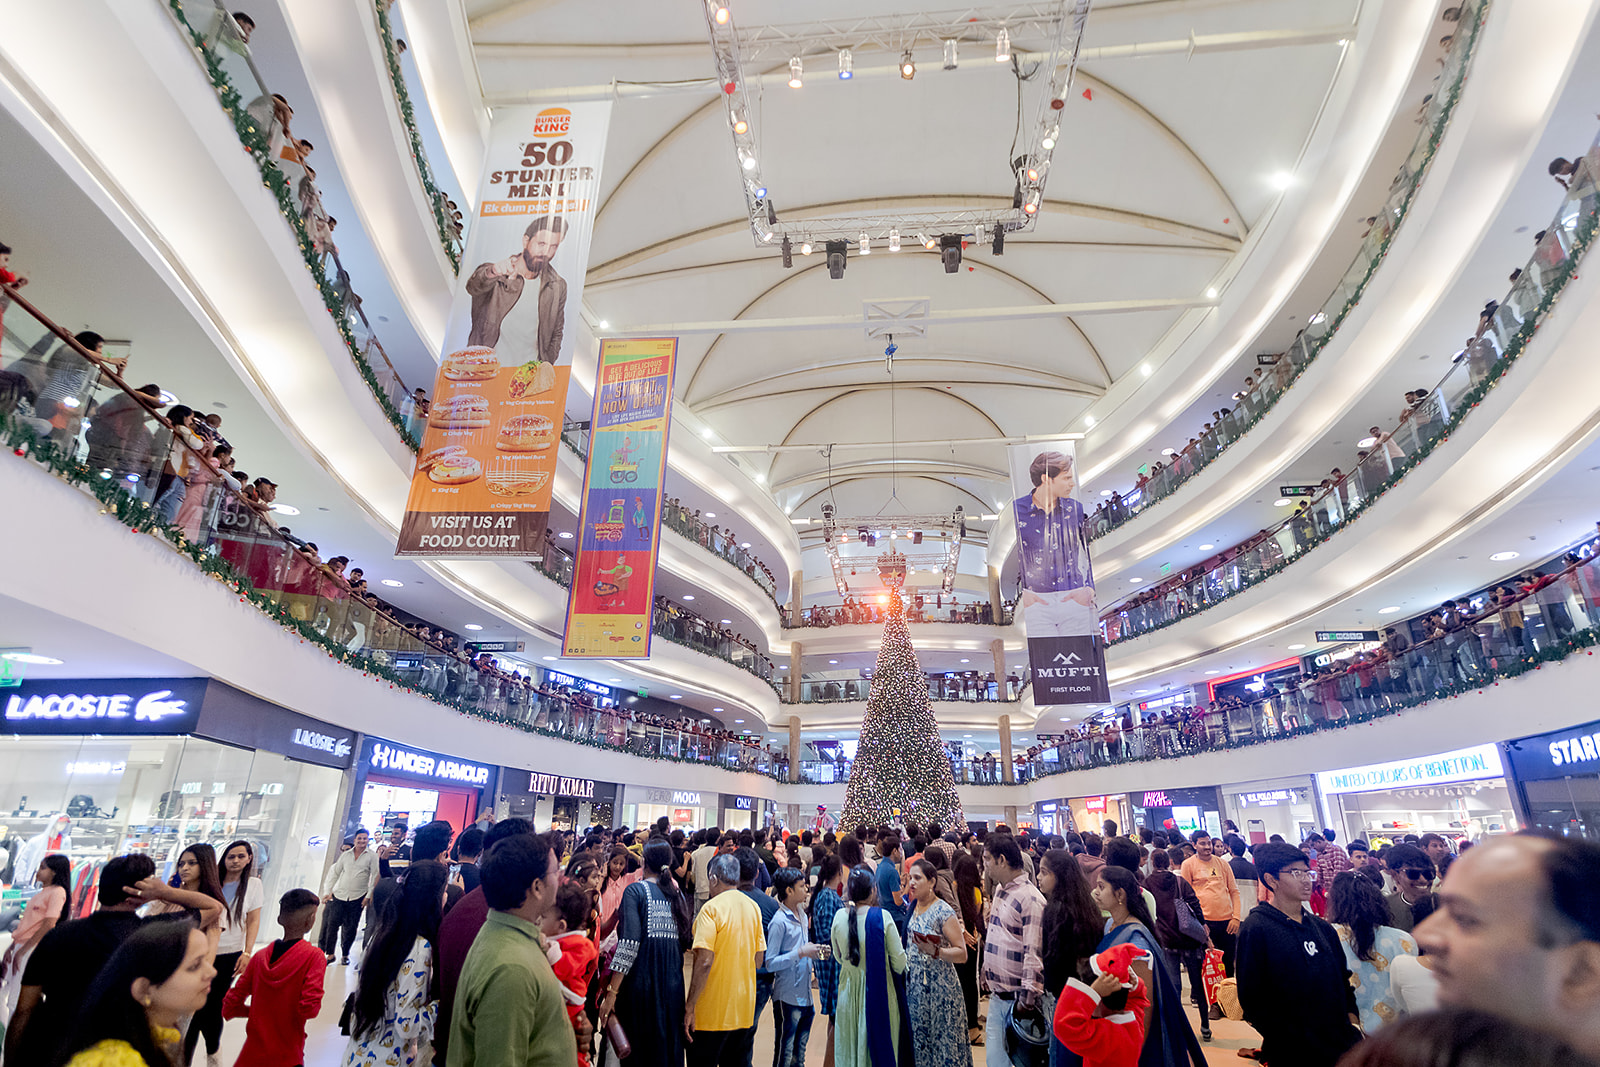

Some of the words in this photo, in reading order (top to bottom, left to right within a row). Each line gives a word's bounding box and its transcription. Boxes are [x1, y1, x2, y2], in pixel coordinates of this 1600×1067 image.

[533, 123, 569, 133] KING
[535, 116, 571, 124] BURGER
[521, 141, 573, 167] 50
[490, 167, 594, 184] STUNNER
[484, 203, 499, 213] Ek
[501, 203, 526, 213] dum
[608, 372, 623, 382] BITE
[624, 370, 636, 379] OUT
[637, 369, 646, 377] OF
[611, 366, 623, 375] GET
[630, 360, 662, 370] DELICIOUS
[602, 399, 628, 415] NOW
[633, 393, 663, 409] OPEN
[430, 516, 471, 529] VISIT
[472, 516, 493, 529] US
[494, 516, 517, 529] AT
[419, 535, 465, 548] FOOD
[466, 535, 520, 548] COURT
[1037, 666, 1101, 678] MUFTI
[5, 694, 133, 719] LACOSTE
[294, 728, 336, 752] LACOSTE
[389, 749, 435, 776] UNDER
[435, 760, 489, 784] ARMOUR
[1330, 774, 1366, 789] UNITED
[1368, 766, 1408, 785] COLORS
[1410, 763, 1424, 779] OF
[528, 772, 559, 795] RITU
[559, 776, 595, 798] KUMAR
[646, 788, 672, 803] VERO
[672, 791, 701, 805] MODA
[736, 797, 752, 809] ONLY
